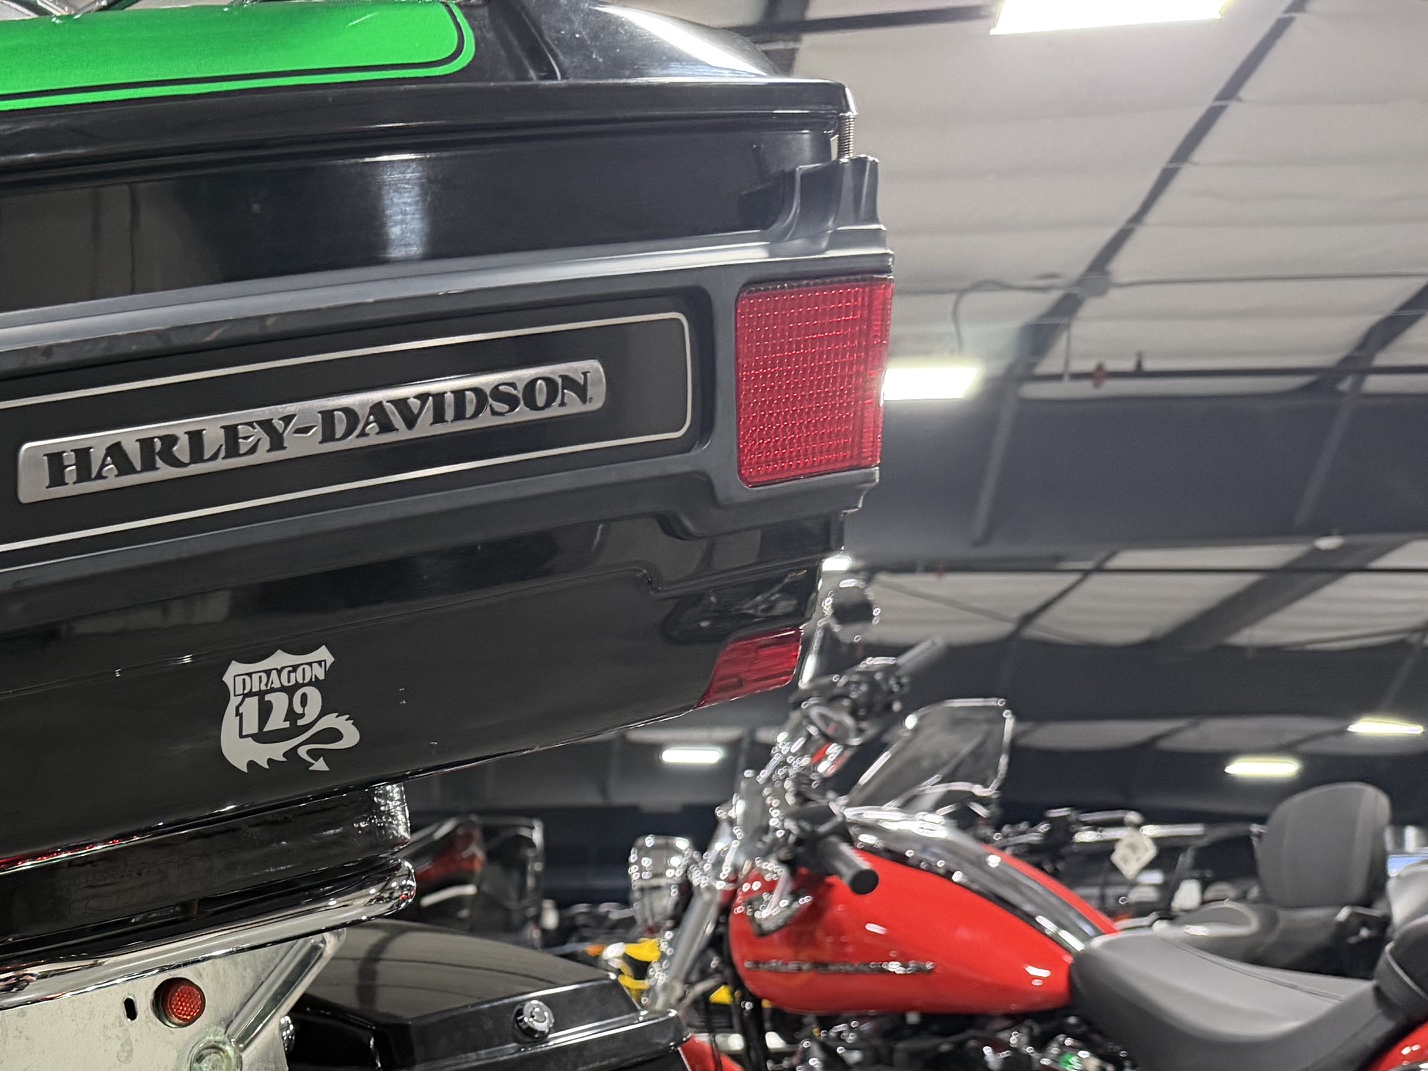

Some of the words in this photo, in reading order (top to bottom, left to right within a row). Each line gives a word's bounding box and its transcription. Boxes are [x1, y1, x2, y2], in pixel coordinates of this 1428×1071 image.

[43, 371, 590, 489] HARLEY-DAVIDSON
[234, 661, 325, 696] DRAGON
[239, 686, 322, 735] 129
